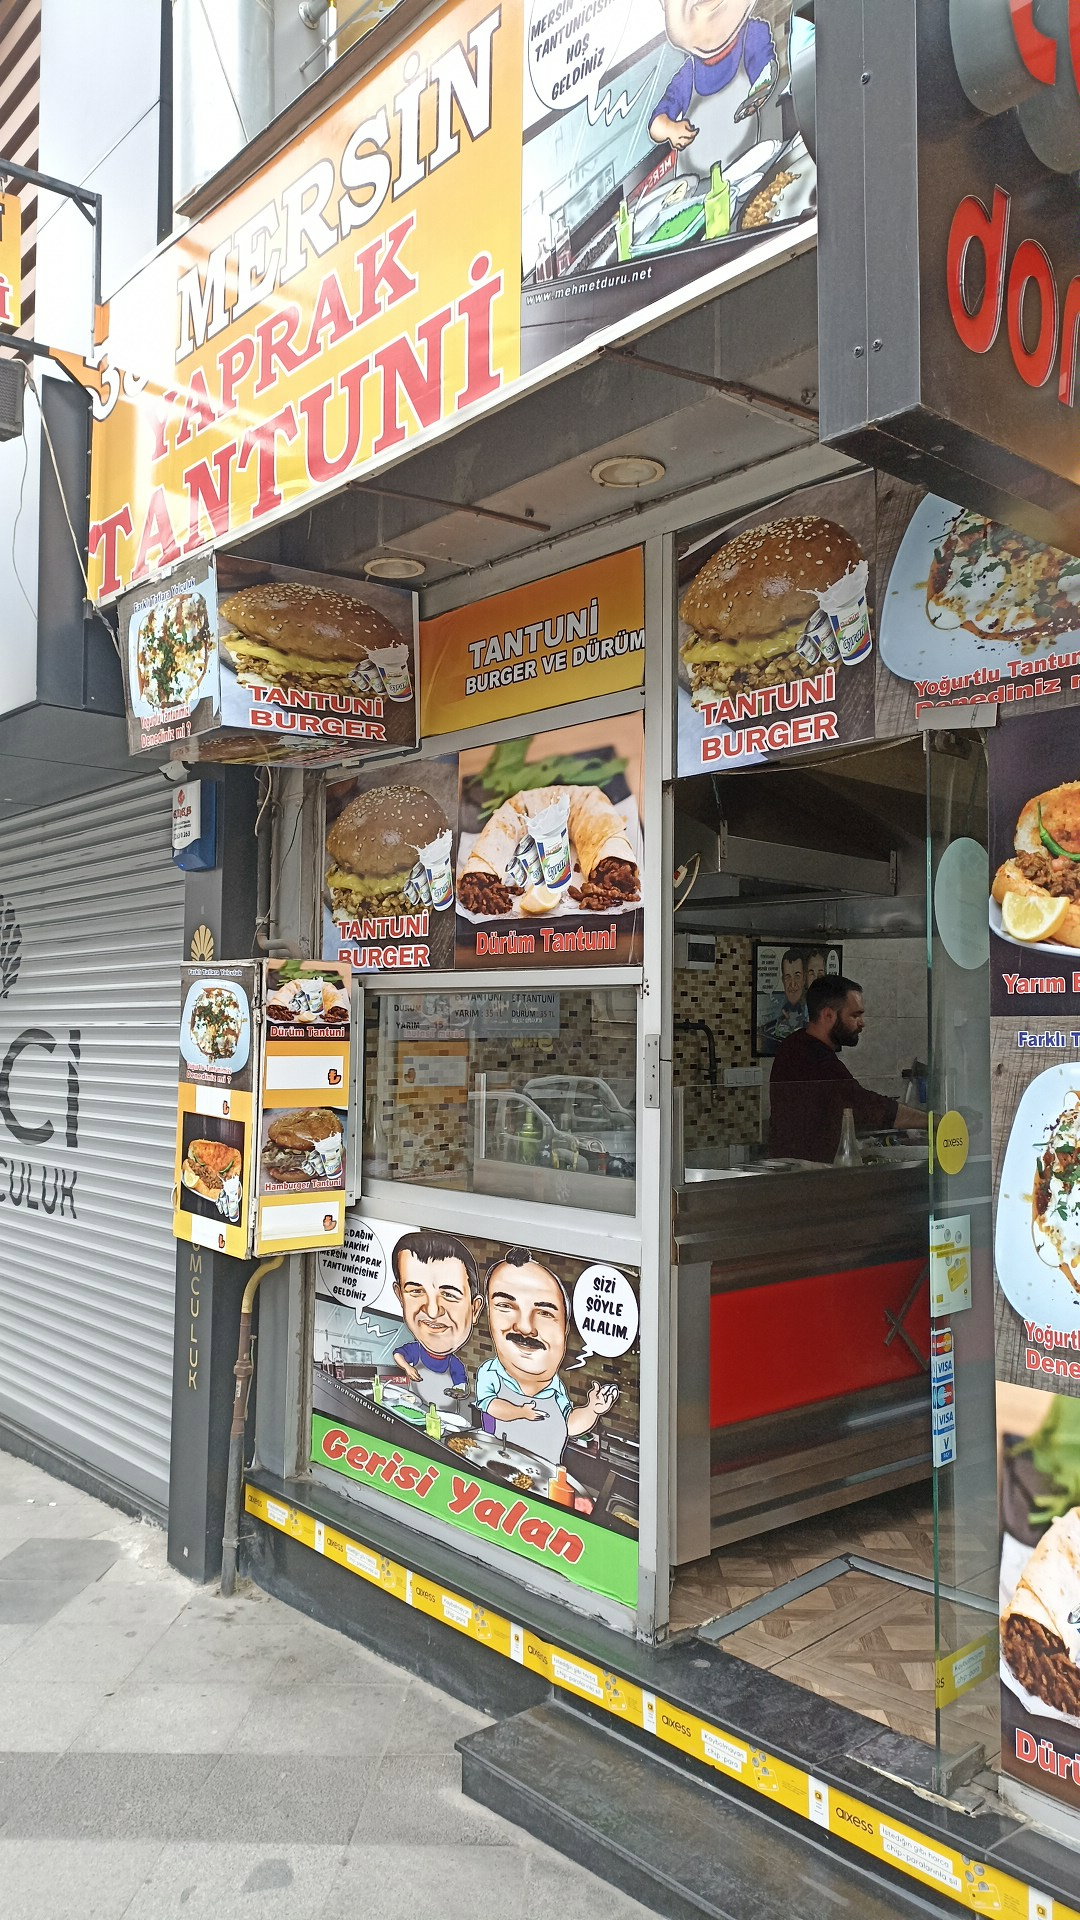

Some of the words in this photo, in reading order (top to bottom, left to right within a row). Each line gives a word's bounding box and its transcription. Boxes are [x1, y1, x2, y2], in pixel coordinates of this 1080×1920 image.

[566, 33, 589, 64] HOŞ
[552, 47, 605, 100] GELDİNİZ
[175, 8, 502, 364] MERSİN
[526, 267, 652, 305] www.mehmetduru.net
[148, 213, 418, 461] YAPRAK
[88, 252, 502, 597] TANTUNİ
[468, 597, 598, 669] TANTUNİ
[465, 660, 537, 695] BURGER
[541, 651, 567, 675] VE
[572, 628, 645, 667] DÜRÜM
[700, 666, 836, 728] TANTUNİ
[914, 667, 1000, 698] Yoğurtlu
[246, 683, 384, 718] TANTUNİ
[249, 708, 387, 741] BURGER
[701, 711, 840, 763] BURGER
[337, 909, 429, 940] TANTUNİ
[475, 931, 534, 956] Dürüm
[540, 923, 617, 952] Tantuni
[337, 944, 430, 969] BURGER
[1002, 974, 1065, 994] Yarım
[270, 1025, 304, 1037] Dürüm
[307, 1026, 345, 1037] Tantuni
[1018, 1030, 1066, 1047] Farklı
[943, 1137, 963, 1148] axess
[0, 1156, 77, 1219] ULUK
[265, 1181, 310, 1191] Hamburger
[311, 1178, 342, 1188] Tantuni
[345, 1229, 373, 1241] DAĞIN
[322, 1259, 379, 1279] TANTUNİCİSİNE
[350, 1253, 382, 1267] YAPRAK
[333, 1285, 367, 1301] GELDİNİZ
[342, 1276, 358, 1287] HOŞ
[593, 1275, 616, 1293] SİZİ
[586, 1294, 623, 1316] ŞÖYLE
[582, 1317, 628, 1341] ALALIM.
[938, 1360, 952, 1374] VISA
[1025, 1348, 1080, 1379] Dene
[940, 1412, 953, 1425] VISA
[322, 1429, 440, 1499] Gerisi
[448, 1476, 585, 1564] Yalan
[416, 1587, 436, 1603] axess
[528, 1645, 549, 1665] axess
[661, 1715, 692, 1738] axess
[835, 1806, 874, 1835] axess
